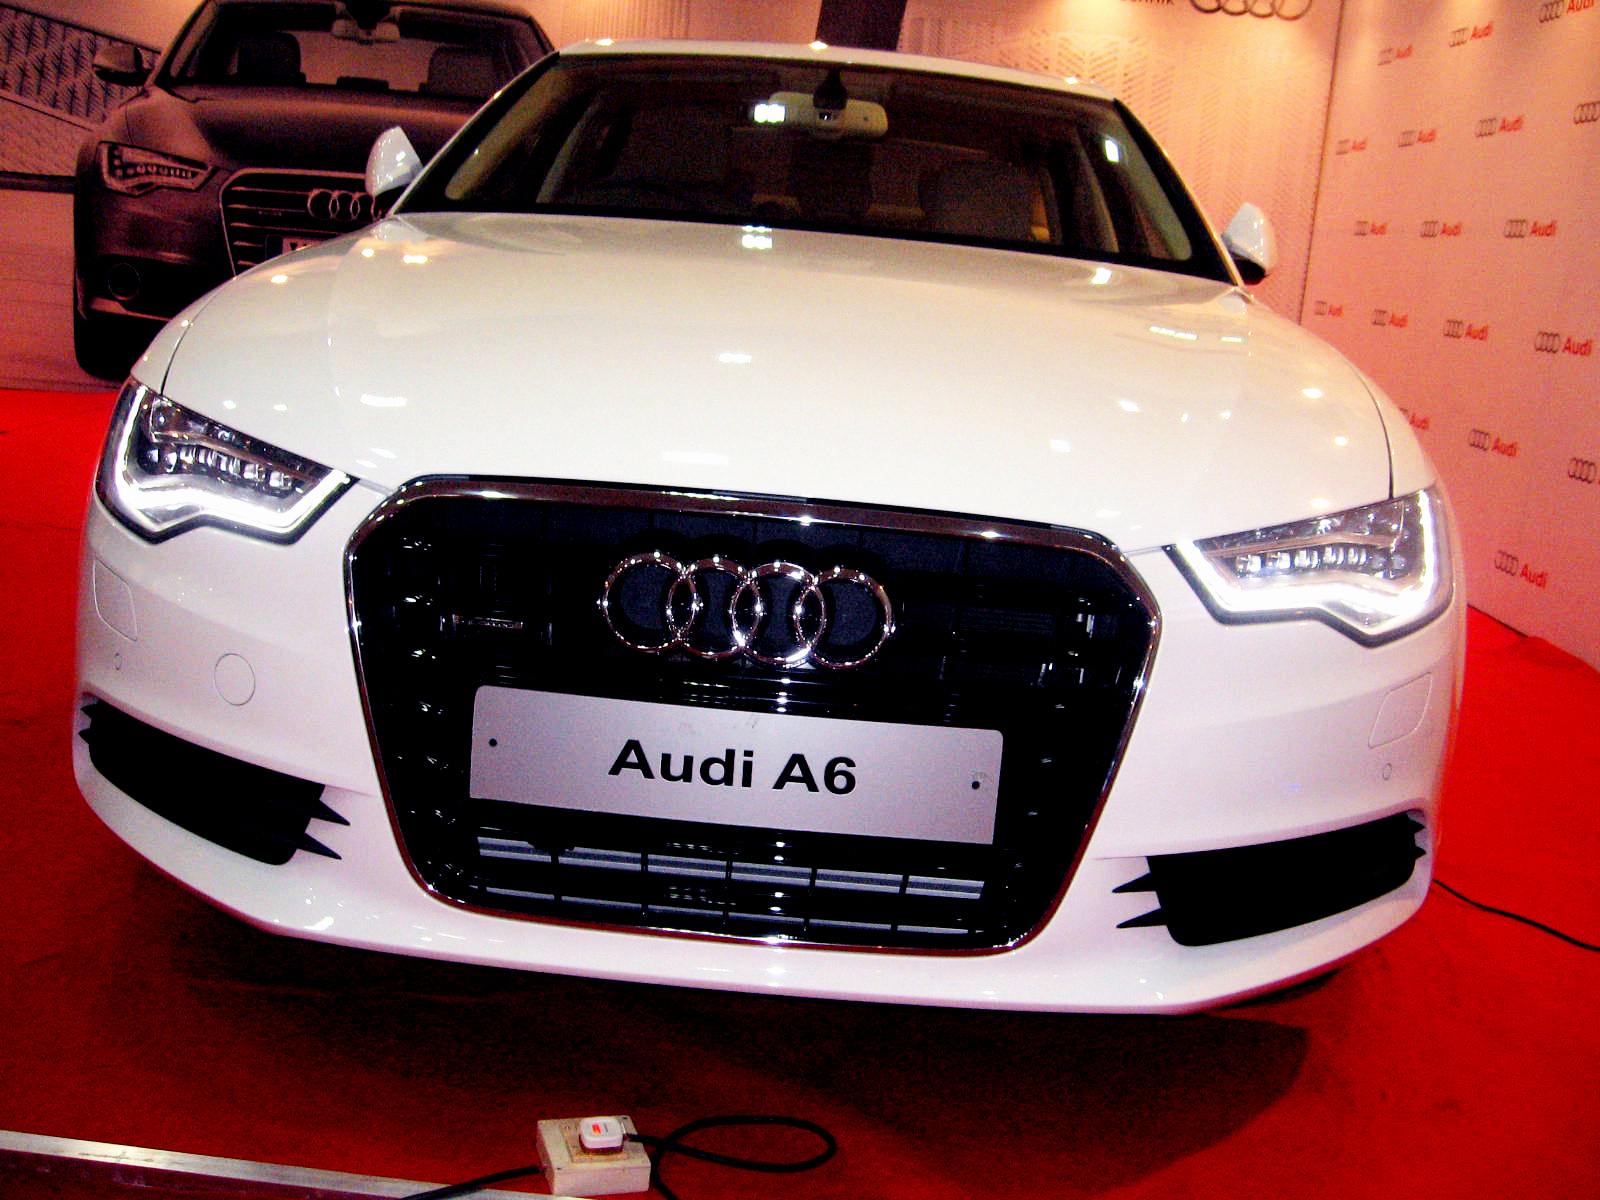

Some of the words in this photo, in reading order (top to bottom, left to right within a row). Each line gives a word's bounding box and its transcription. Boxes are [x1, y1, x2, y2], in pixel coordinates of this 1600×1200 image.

[1470, 22, 1493, 40] Audi
[1498, 115, 1524, 132] Audi
[1440, 222, 1462, 237] Audi
[1530, 219, 1558, 238] Audi
[1464, 323, 1489, 341] Audi
[1561, 337, 1593, 357] Audi
[1491, 437, 1518, 457] Audi
[1519, 563, 1548, 588] Audi
[607, 739, 755, 788] Audi
[772, 753, 858, 795] A6
